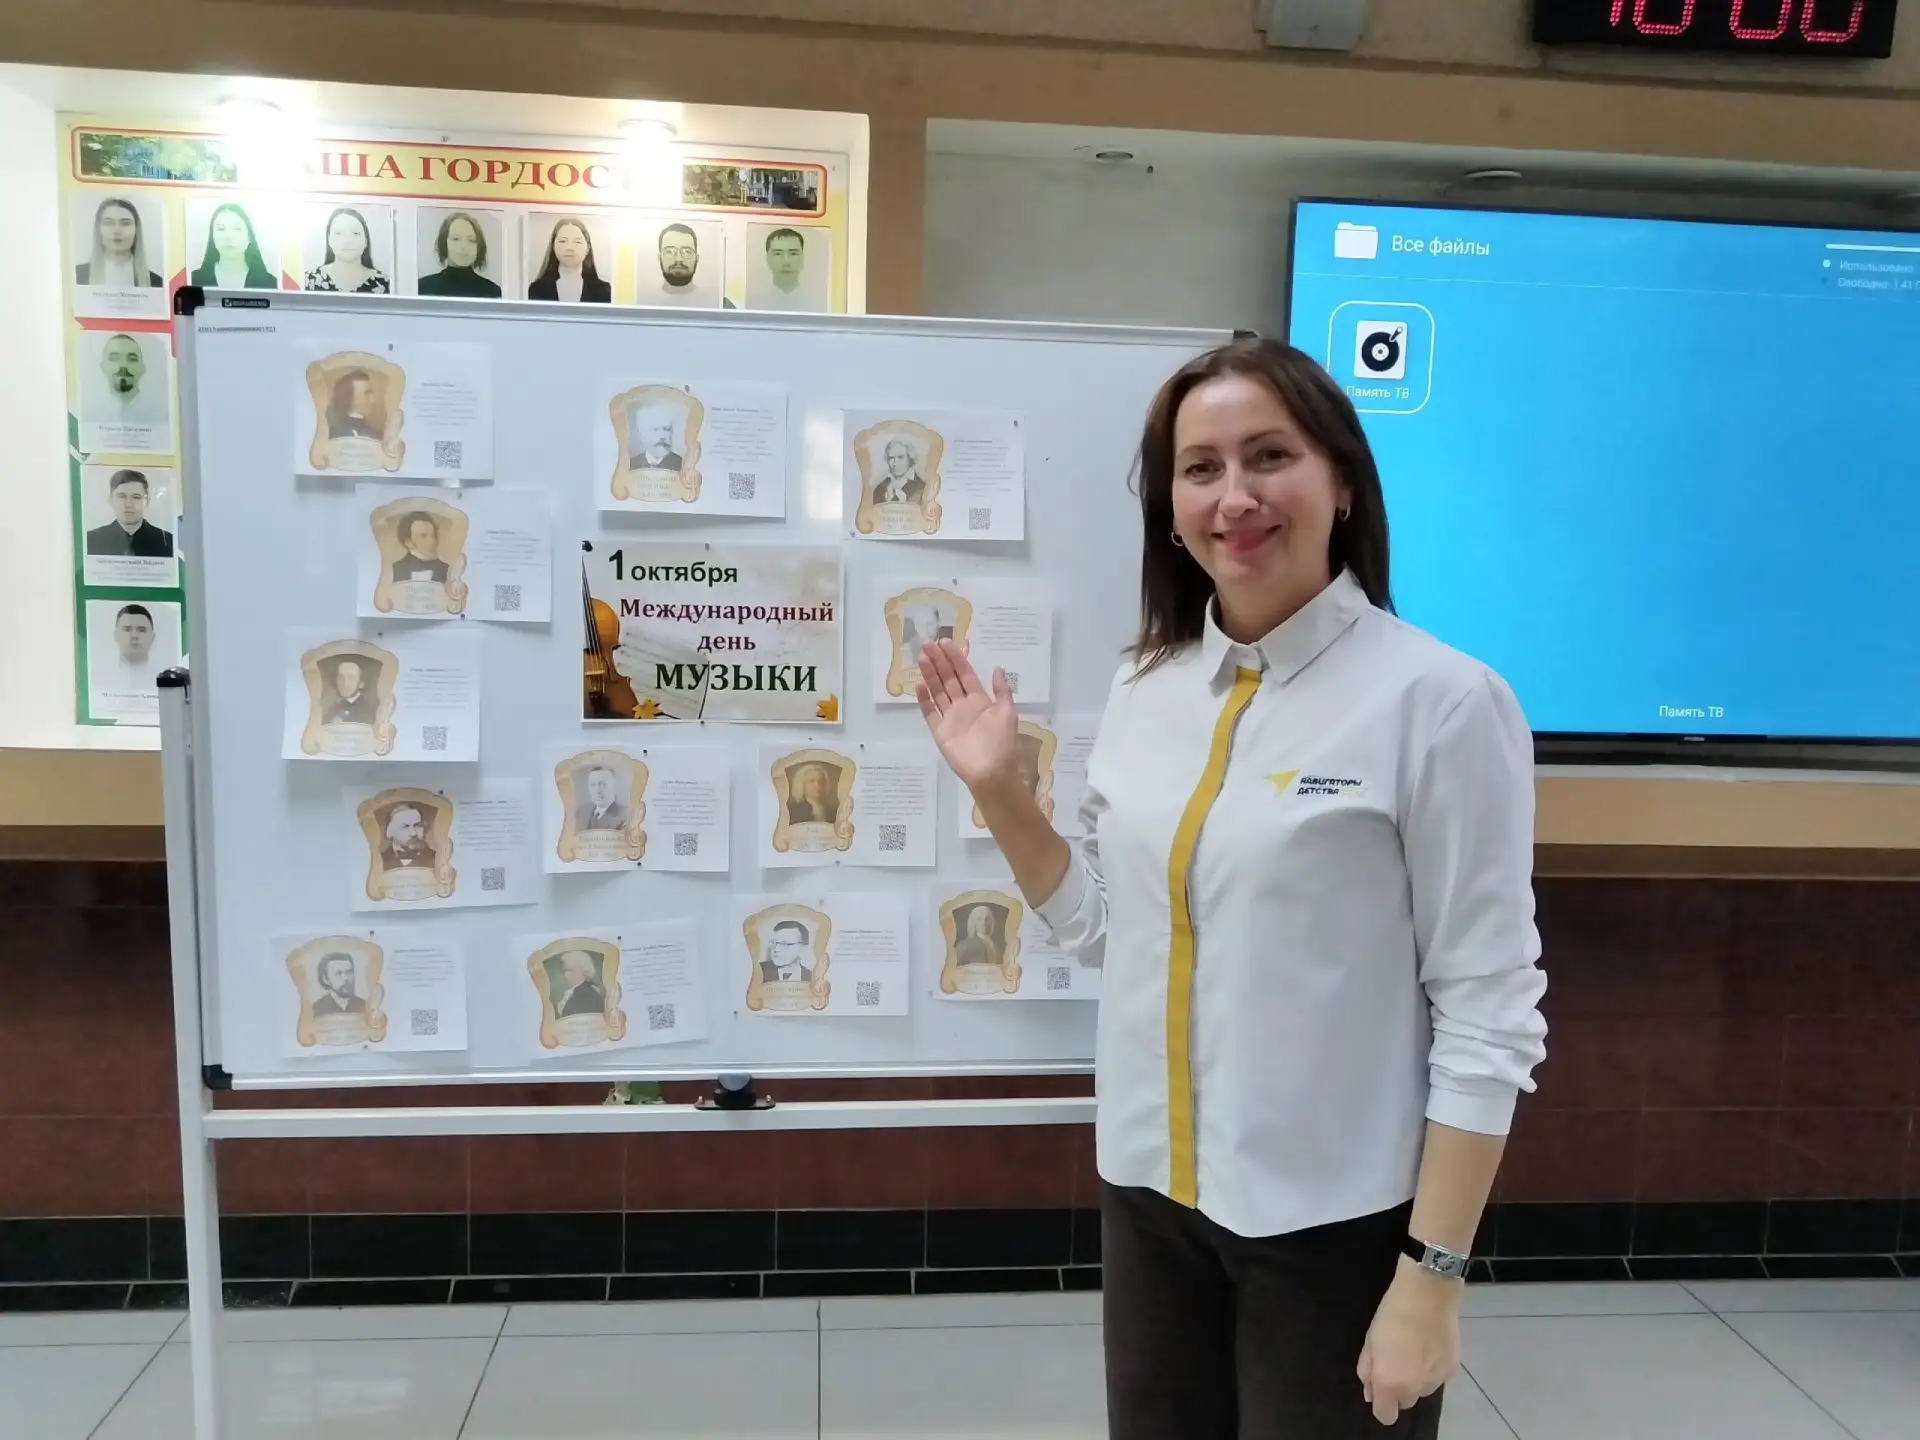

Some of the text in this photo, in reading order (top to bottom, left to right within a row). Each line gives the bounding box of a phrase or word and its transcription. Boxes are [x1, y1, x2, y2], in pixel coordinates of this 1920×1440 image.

[320, 152, 613, 191] ША ГОРДОС
[1391, 234, 1490, 257] Все файлы
[1346, 385, 1410, 399] Память ТВ
[608, 549, 738, 587] 1 октября
[619, 598, 835, 625] Международный
[696, 634, 757, 654] день
[655, 663, 817, 693] МУЗЫКИ
[1658, 705, 1724, 718] Память ТВ
[1296, 787, 1340, 796] ДЕТСТВА
